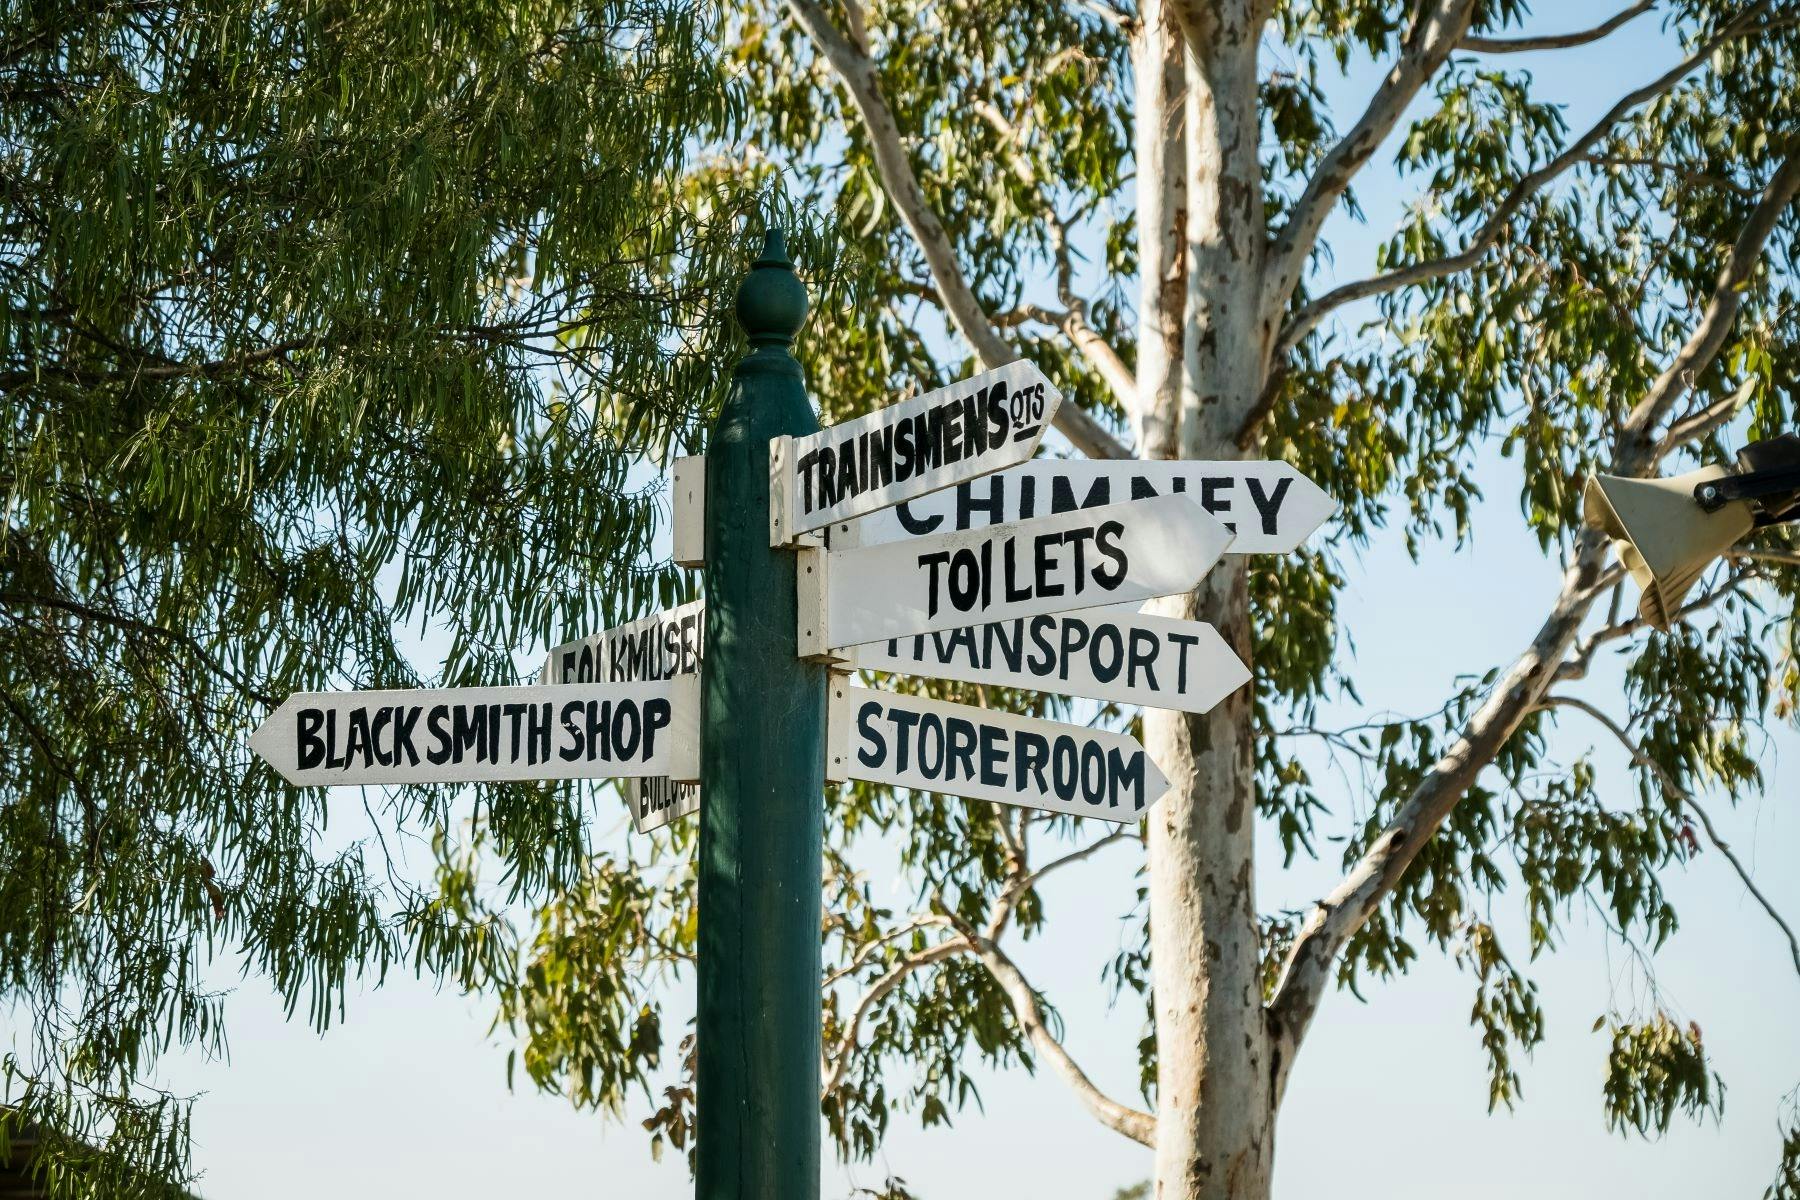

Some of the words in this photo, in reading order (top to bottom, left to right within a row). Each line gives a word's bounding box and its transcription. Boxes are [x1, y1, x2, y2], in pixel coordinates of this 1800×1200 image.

[797, 380, 1010, 516] TRAINSMENS
[918, 520, 1128, 620] TOILETS
[559, 697, 672, 764] SHOP
[857, 701, 1146, 811] STOREROOM
